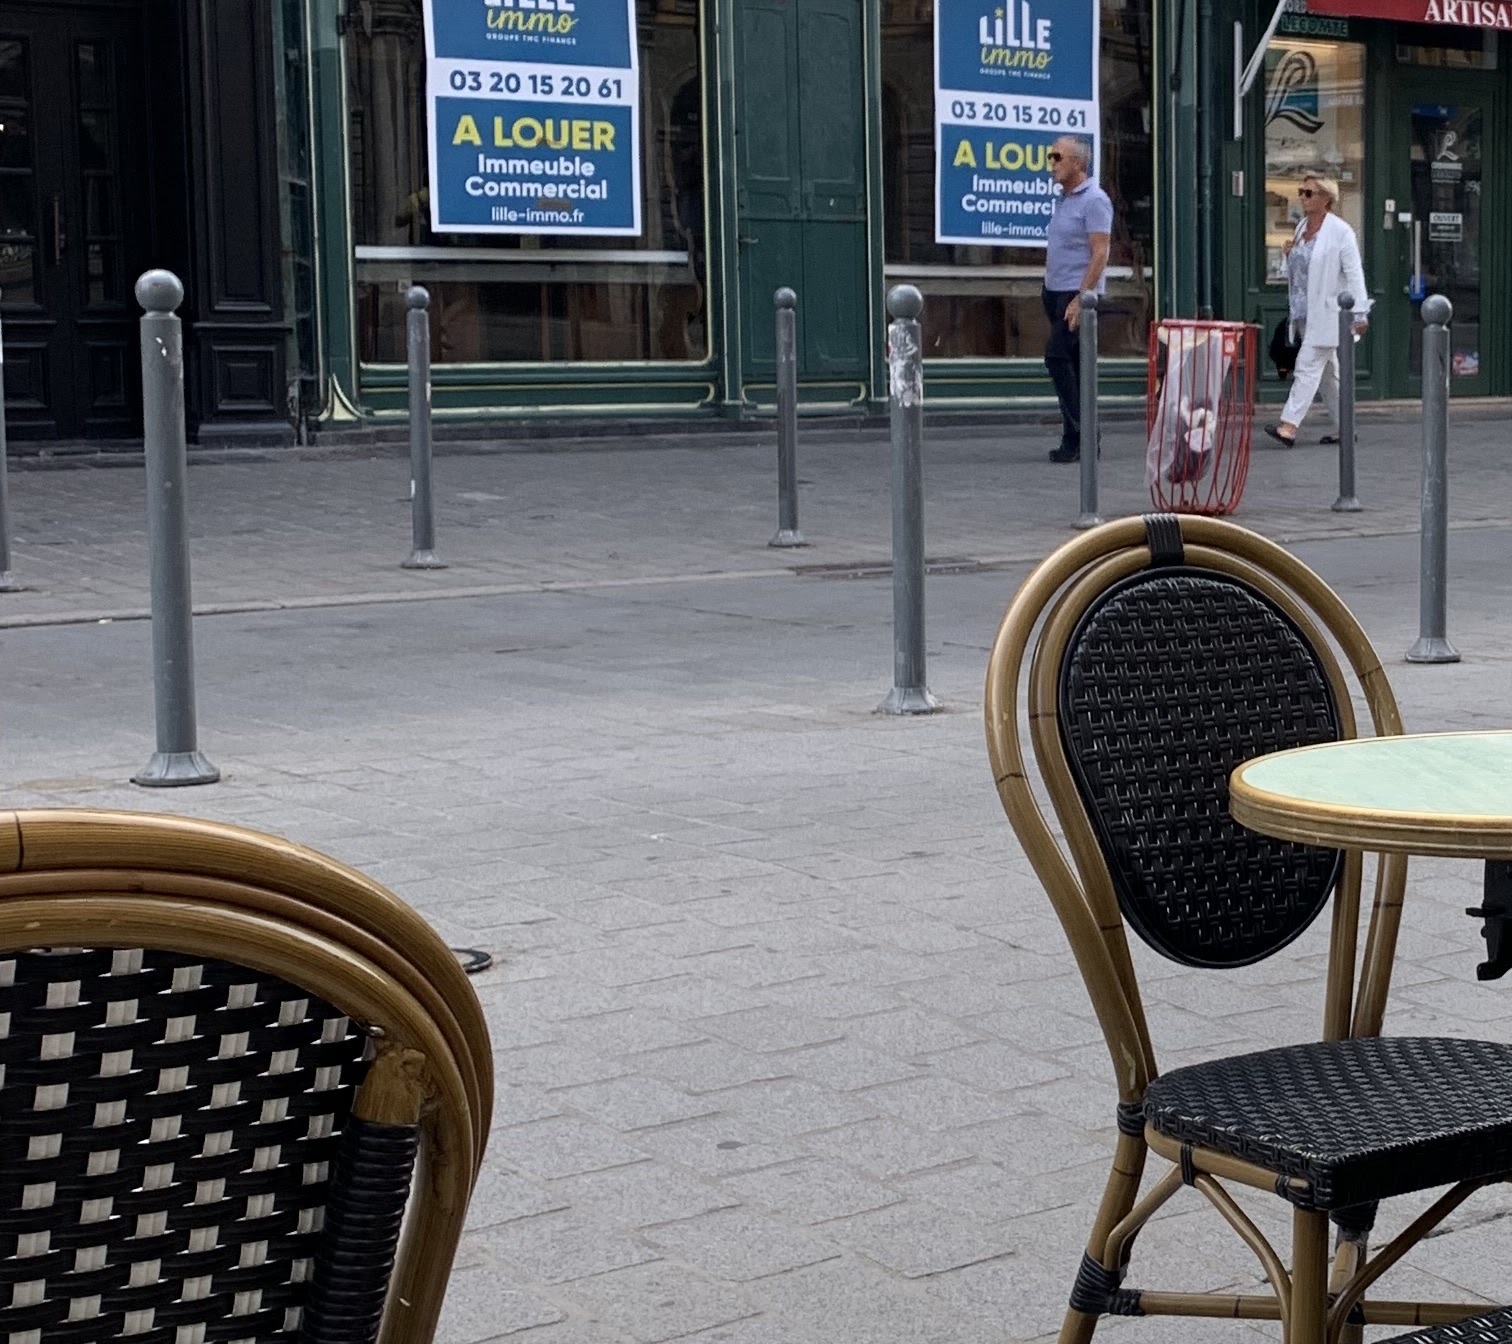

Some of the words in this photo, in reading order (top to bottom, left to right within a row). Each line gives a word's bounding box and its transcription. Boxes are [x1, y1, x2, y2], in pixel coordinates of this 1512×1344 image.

[486, 8, 579, 34] immo
[981, 46, 1054, 70] immo
[449, 69, 482, 92] 03
[489, 72, 521, 94] 20
[528, 74, 553, 95] 15
[561, 76, 591, 98] 20
[598, 78, 622, 99] 61
[951, 100, 976, 120] 03
[982, 102, 1007, 122] 20
[1012, 104, 1033, 123] 15
[1038, 107, 1061, 126] 20
[1067, 109, 1086, 128] 61
[452, 115, 483, 146] A
[494, 116, 616, 151] LOUER
[478, 153, 595, 177] Immeuble
[953, 139, 976, 168] A
[465, 176, 608, 200] Commercial
[972, 174, 1064, 196] Immeuble
[491, 206, 585, 225] lille-immo.fr
[961, 194, 1057, 216] Commerci
